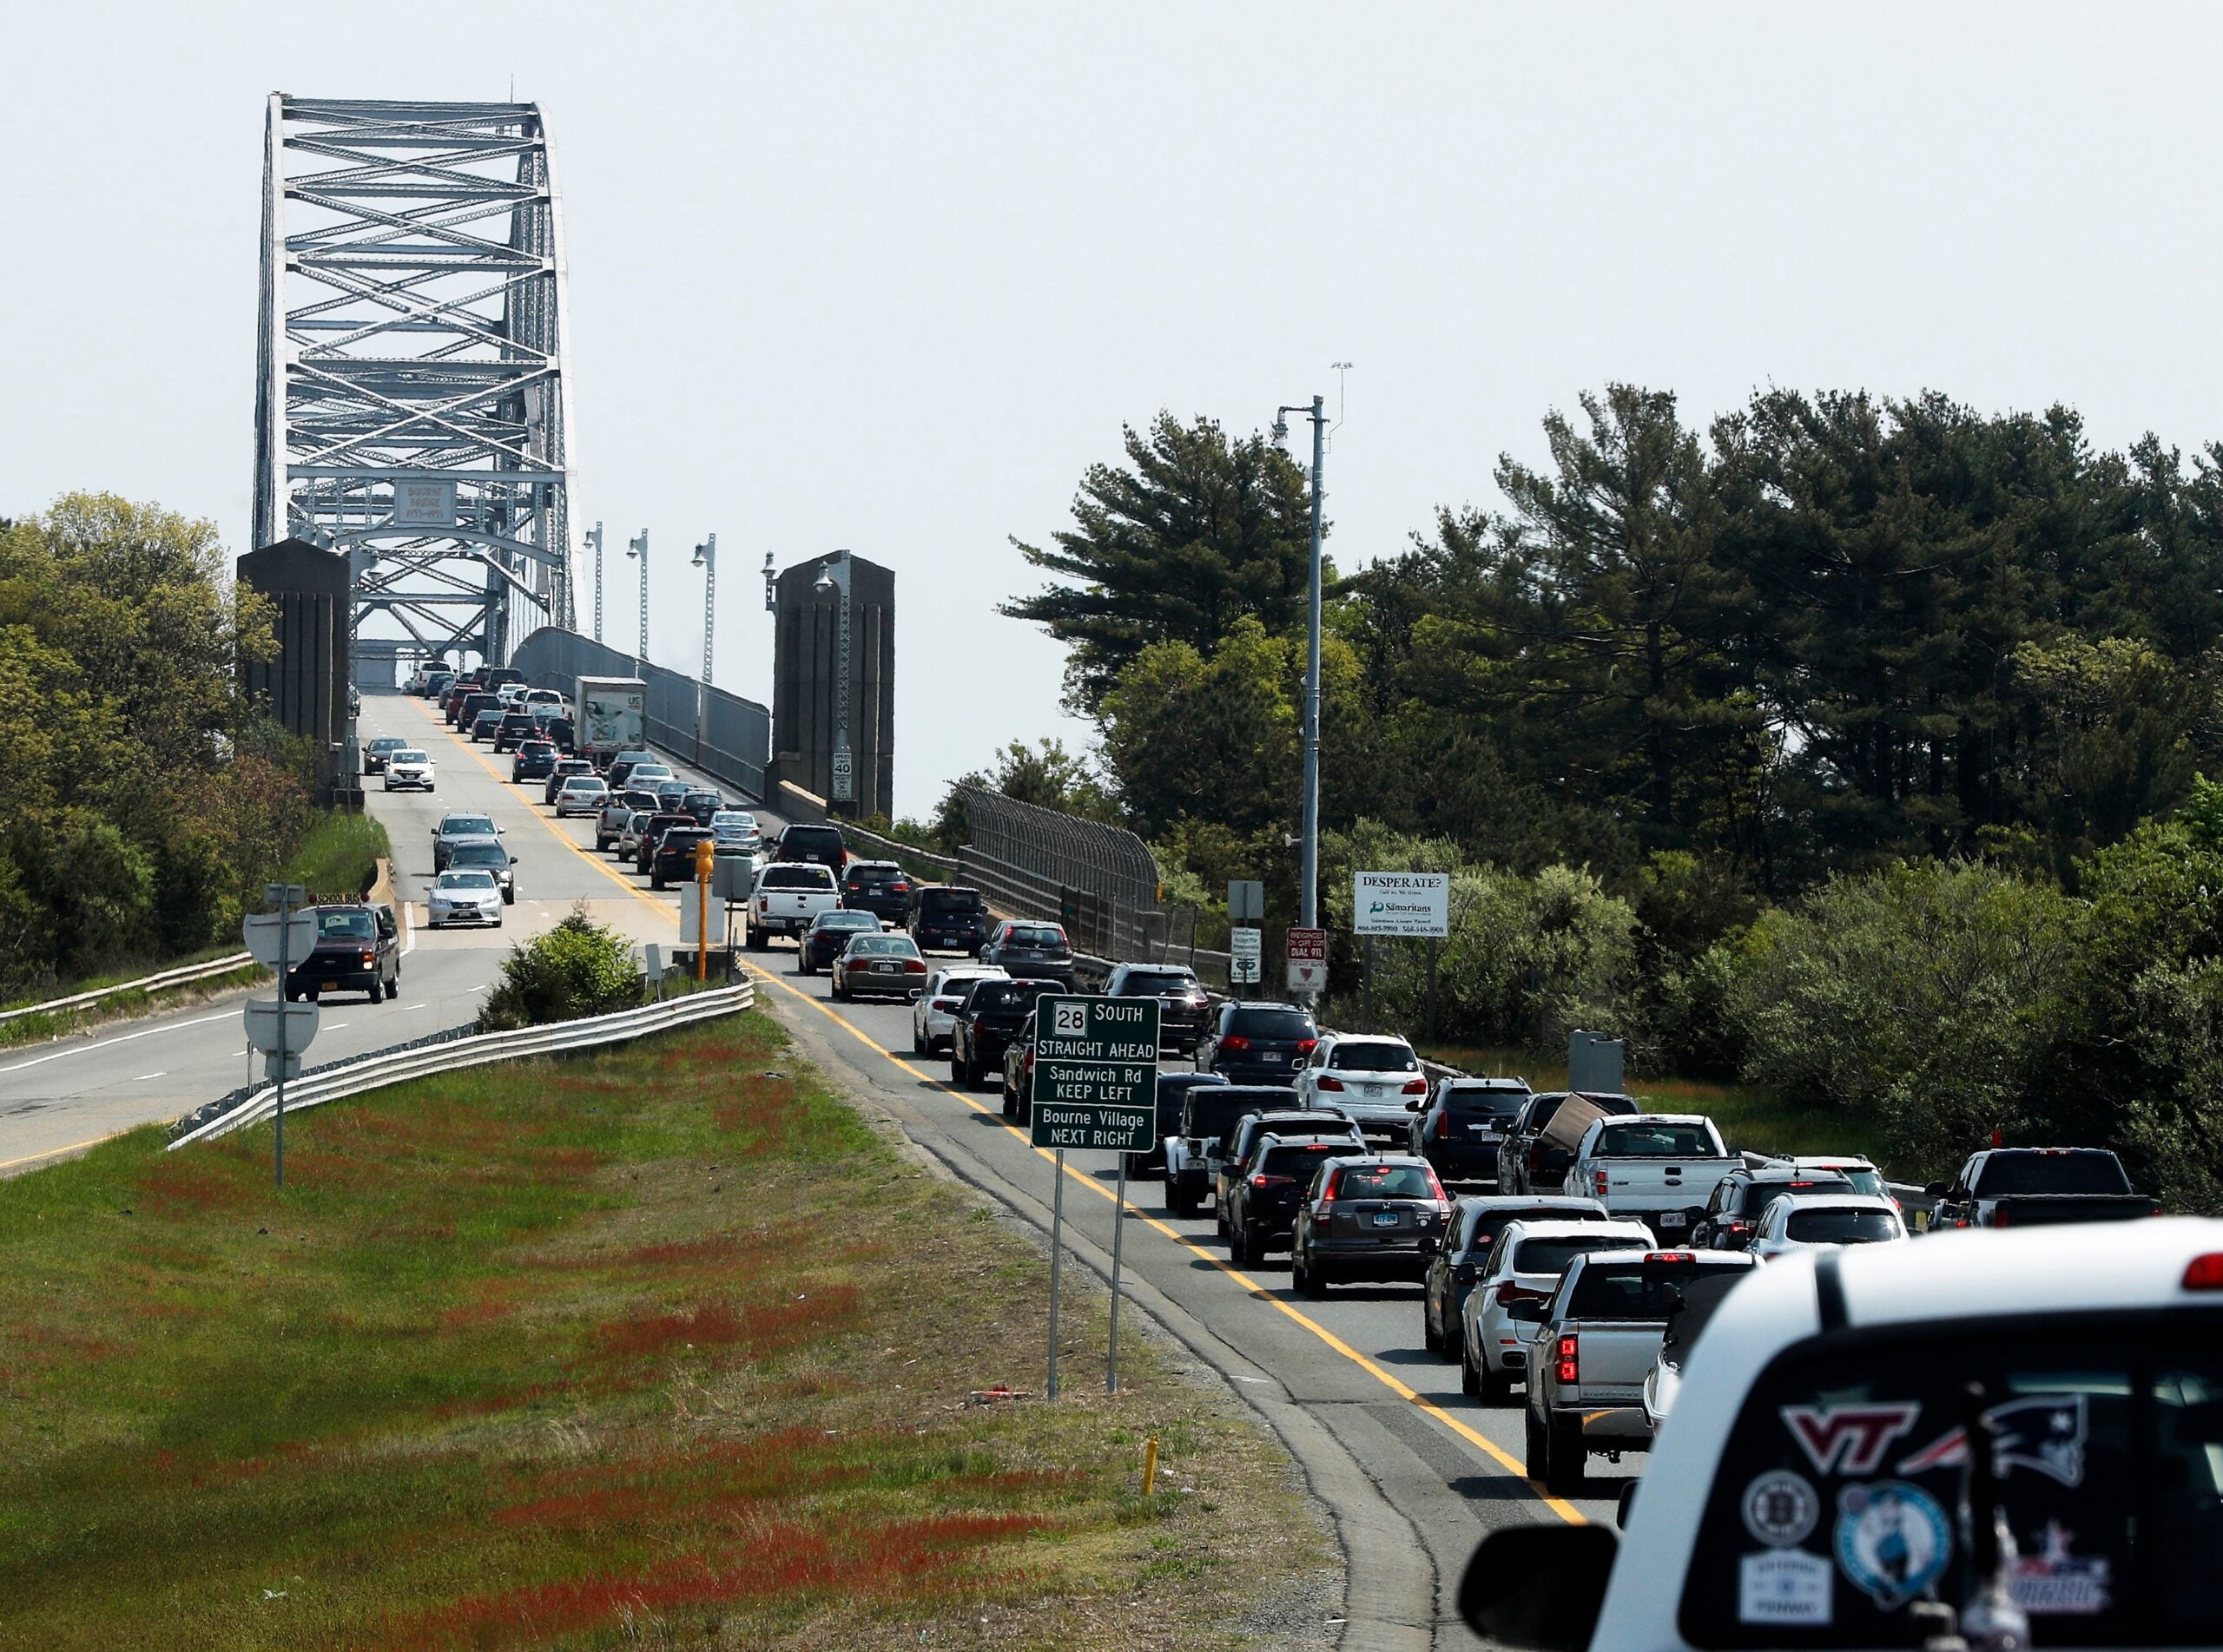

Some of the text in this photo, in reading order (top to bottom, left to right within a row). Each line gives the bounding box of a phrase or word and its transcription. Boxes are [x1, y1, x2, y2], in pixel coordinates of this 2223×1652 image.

[834, 764, 850, 773] 40
[1362, 876, 1441, 888] DESPERATE?
[345, 892, 360, 904] BUS
[1385, 903, 1431, 912] Samaritans
[1291, 948, 1322, 957] DIAL 911
[1058, 1004, 1143, 1030] 28 SOUTH
[1039, 1040, 1154, 1058] STRAIGHT AHEAD
[1050, 1065, 1142, 1083] Sandwich Rd
[1057, 1083, 1132, 1100] KEEP LEFT
[1043, 1109, 1144, 1130] Bourne Village
[1051, 1129, 1134, 1145] NEXT RIGHT
[1779, 1401, 1922, 1477] VT
